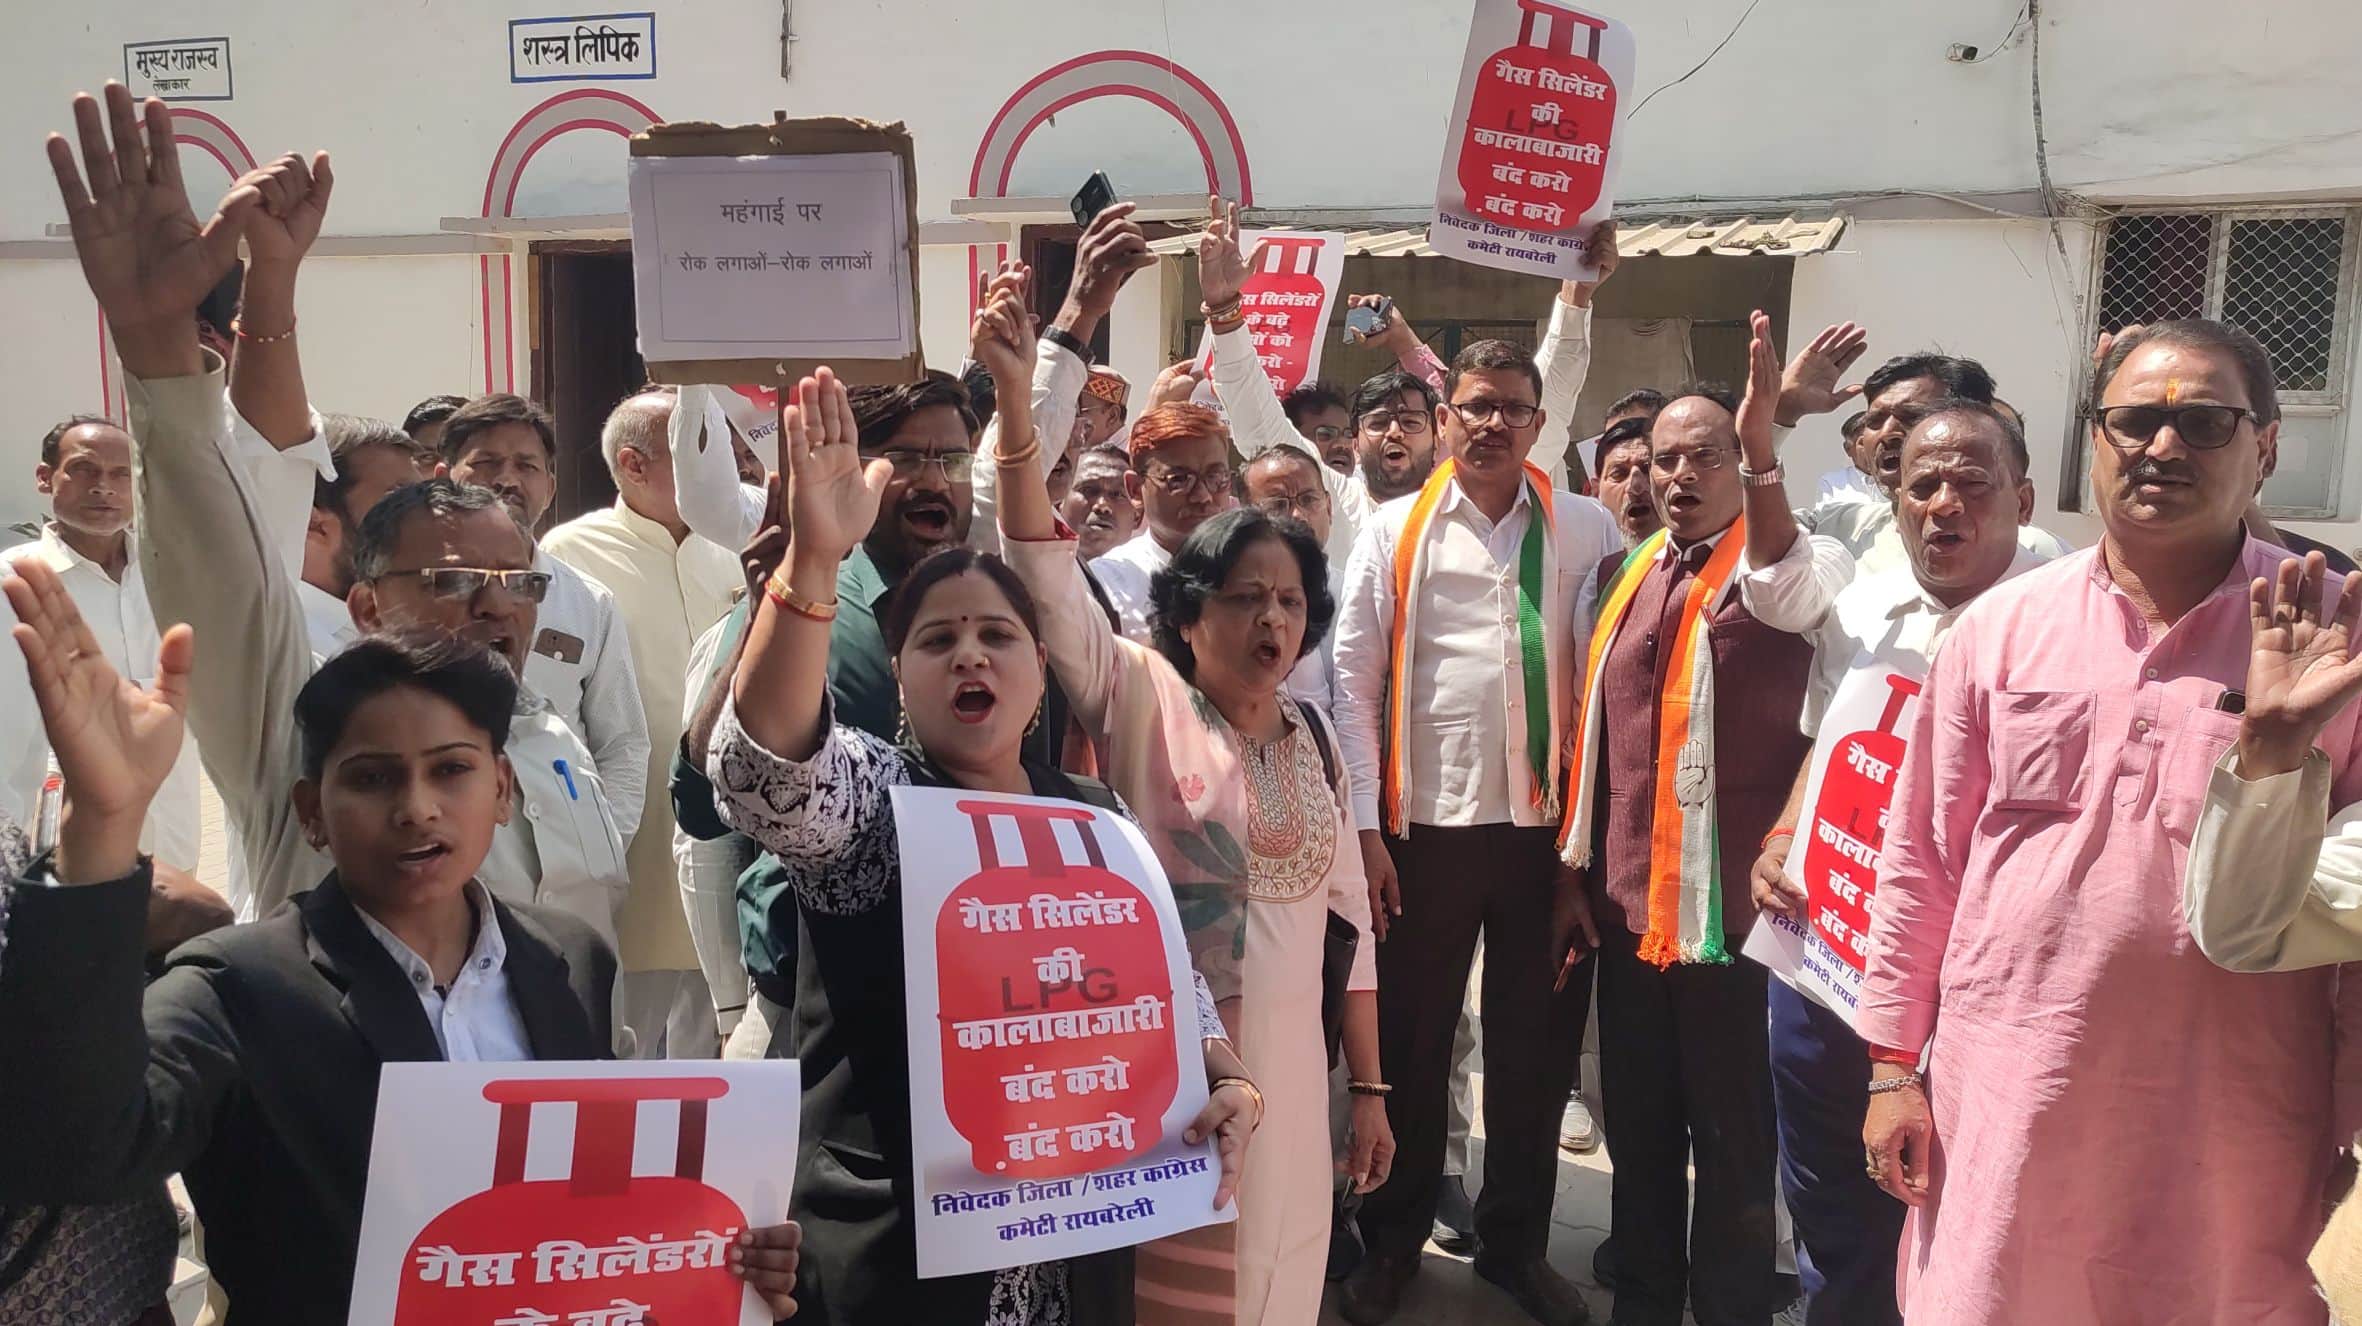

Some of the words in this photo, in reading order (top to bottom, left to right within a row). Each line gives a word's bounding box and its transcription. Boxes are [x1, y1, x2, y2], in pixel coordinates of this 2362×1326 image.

[135, 50, 170, 79] मुख्य
[171, 47, 219, 71] राजस्व
[522, 36, 571, 65] शस्त्र
[573, 25, 641, 65] लिपिक
[152, 75, 192, 91] लेखाकार
[1495, 59, 1535, 87] गैस
[1537, 67, 1608, 101] सिलेंडर
[1530, 102, 1563, 125] की
[1473, 127, 1603, 166] कालाबाजारी
[1492, 162, 1527, 185] बंद
[1529, 170, 1572, 193] करो
[719, 196, 785, 225] महंगाई
[796, 203, 823, 222] पर
[1439, 213, 1481, 233] निवेदक
[1484, 222, 1518, 240] जिला
[678, 250, 707, 272] रोक
[1466, 239, 1503, 255] कमेटी
[1504, 246, 1558, 265] रायबरेली
[1260, 291, 1322, 308] सिलेंडरों
[1269, 332, 1294, 348] को
[1847, 739, 1894, 784] गैस
[1828, 868, 1861, 906] बंद
[958, 895, 1023, 934] गैस
[1027, 891, 1140, 930] सिलेंडर
[1771, 911, 1817, 947] निवेदक
[1817, 939, 1844, 973] जिला
[1032, 946, 1086, 984] की
[1802, 954, 1833, 987] कमेटी
[1001, 967, 1119, 1013] LPG
[952, 994, 1166, 1050] कालाबाजारी
[1000, 1064, 1057, 1103] बंद
[1061, 1055, 1130, 1095] करो
[931, 1192, 1012, 1217] निवेदक
[1016, 1178, 1073, 1204] जिला
[996, 1213, 1058, 1242] कमेटी
[1062, 1197, 1156, 1231] रायबरेली
[415, 1245, 523, 1288] गैस
[532, 1228, 739, 1284] सिलेंडरों
